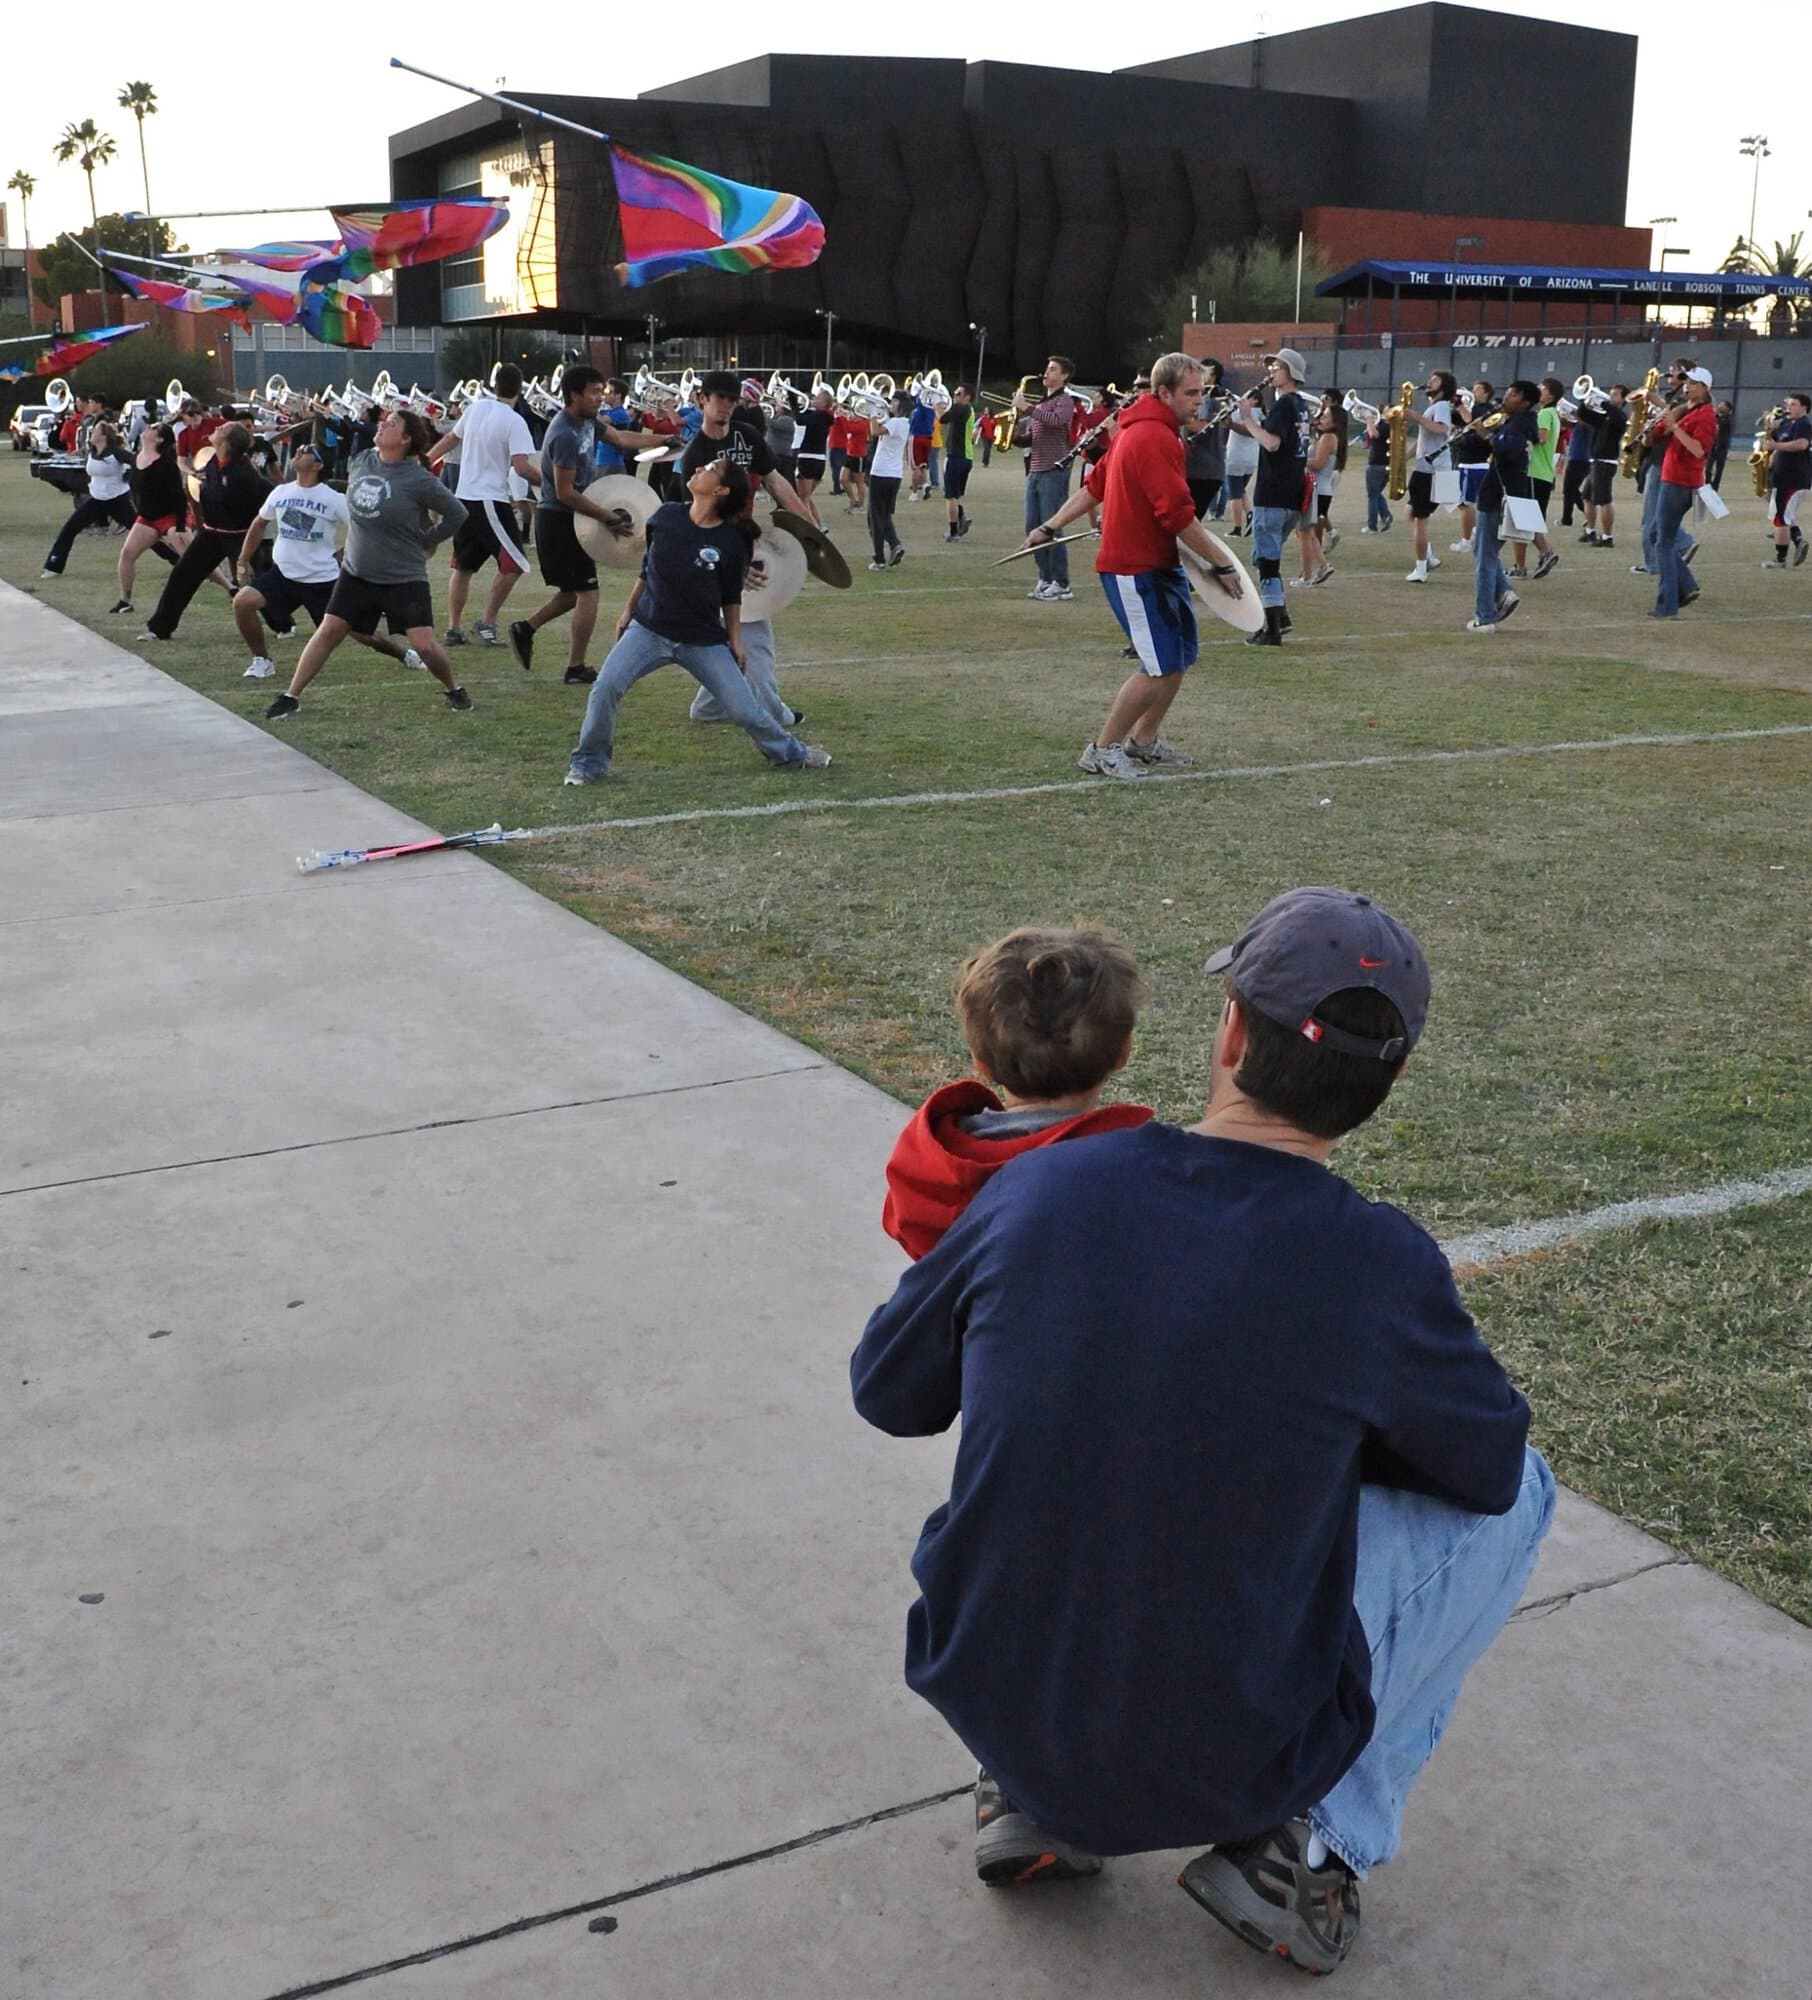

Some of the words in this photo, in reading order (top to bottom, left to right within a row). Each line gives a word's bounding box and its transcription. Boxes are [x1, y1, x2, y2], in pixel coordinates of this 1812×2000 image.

[1409, 271, 1430, 284] THE
[1444, 272, 1505, 286] UNIVERSITY
[1519, 276, 1532, 288] OF
[1547, 276, 1593, 289] ARIZONA
[1685, 281, 1723, 293] ROBSON
[1735, 283, 1766, 295] TENNIS
[1777, 285, 1810, 296] CENTER
